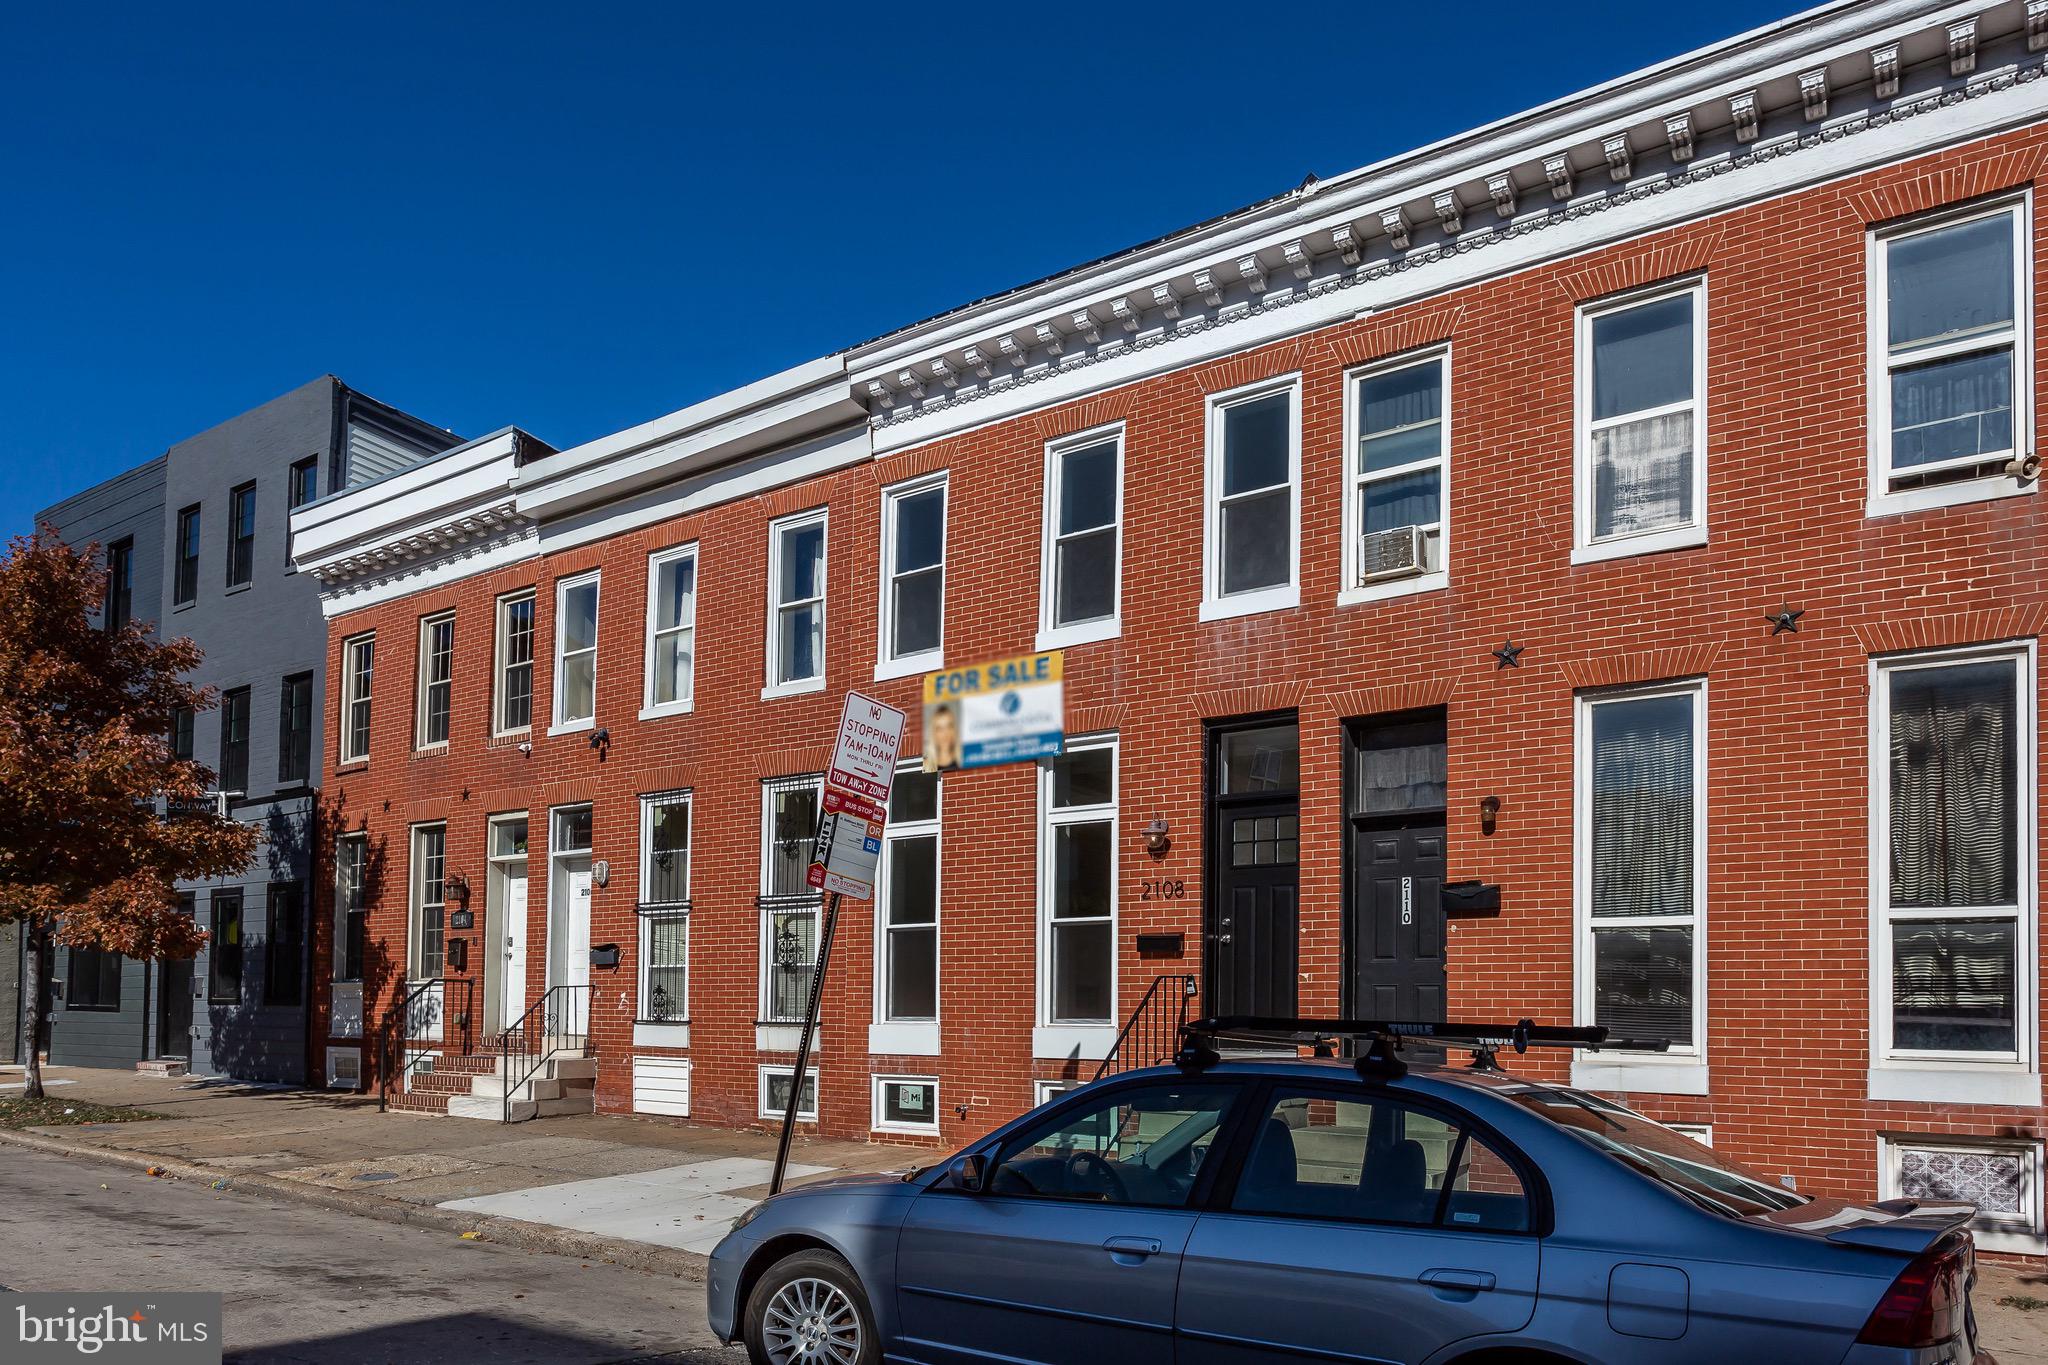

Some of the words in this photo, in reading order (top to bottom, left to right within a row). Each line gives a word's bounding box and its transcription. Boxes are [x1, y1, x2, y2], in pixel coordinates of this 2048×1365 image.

[935, 669, 980, 697] FOR
[987, 656, 1050, 688] SALE
[869, 705, 882, 720] NO
[846, 718, 896, 747] STOPPING
[844, 734, 892, 763] 7AM-10AM
[847, 753, 859, 761] MON
[860, 757, 874, 767] THRU
[833, 771, 848, 785] TOW
[848, 777, 868, 792] AWAY
[868, 784, 887, 799] ZONE
[845, 801, 857, 810] BUS
[857, 805, 873, 815] STOP
[817, 820, 832, 857] LINK
[869, 825, 881, 838] OR
[866, 840, 877, 852] BL
[831, 877, 840, 885] NO
[839, 880, 866, 892] STOPPING
[1141, 880, 1185, 900] 2108
[1403, 878, 1411, 924] 2110
[1388, 1023, 1434, 1036] THULE
